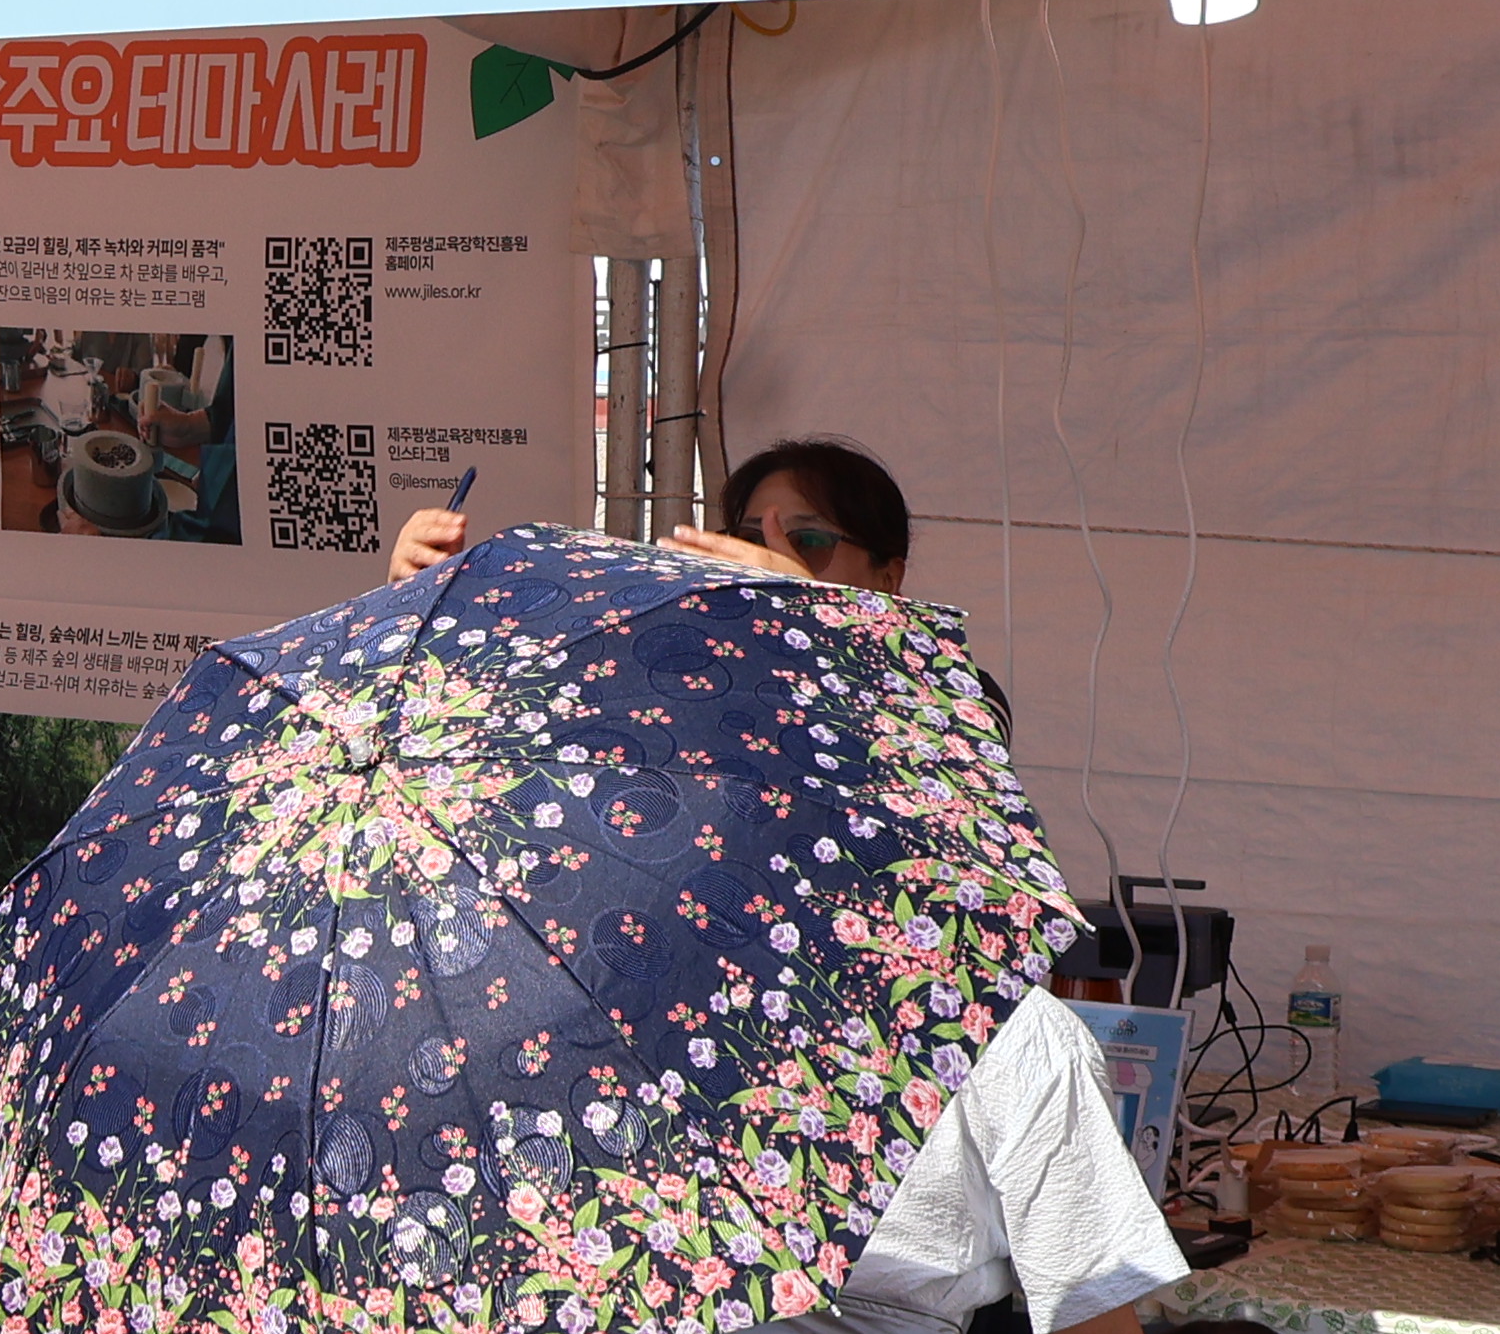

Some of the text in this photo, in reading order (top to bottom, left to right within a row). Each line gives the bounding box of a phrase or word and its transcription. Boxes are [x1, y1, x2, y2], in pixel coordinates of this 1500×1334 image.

[2, 52, 117, 154] 주요
[126, 47, 263, 155] 테마
[273, 46, 416, 155] 사례
[2, 236, 41, 255] 모금의
[43, 236, 74, 258] 힐링,
[75, 237, 101, 257] 제주
[103, 238, 144, 258] 녹차와
[146, 239, 188, 259] 커피의
[384, 235, 529, 253] 제주평생교육장학진흥원
[20, 260, 60, 280] 길러낸
[119, 263, 134, 282] 차
[137, 263, 179, 283] 문화를
[182, 264, 229, 286] 배우고,
[384, 255, 434, 272] 홈페이지
[33, 284, 72, 305] 마음의
[74, 286, 117, 307] 여유는
[118, 287, 148, 308] 찾는
[150, 288, 206, 309] 프로그램
[384, 283, 482, 301] www.jiles.or.kr
[387, 426, 528, 445] 제주평생교육장학진흥원
[387, 445, 450, 463] 인스타그램
[15, 622, 46, 645] 힐링,
[49, 623, 104, 646] 숲속에서
[106, 626, 149, 650] 느끼는
[152, 628, 180, 652] 진짜
[3, 643, 18, 664] 등
[21, 644, 50, 666] 제주
[52, 647, 80, 669] 숲의
[82, 648, 124, 673] 생태를
[126, 651, 169, 675] 배우며
[86, 675, 138, 698] 치유하는
